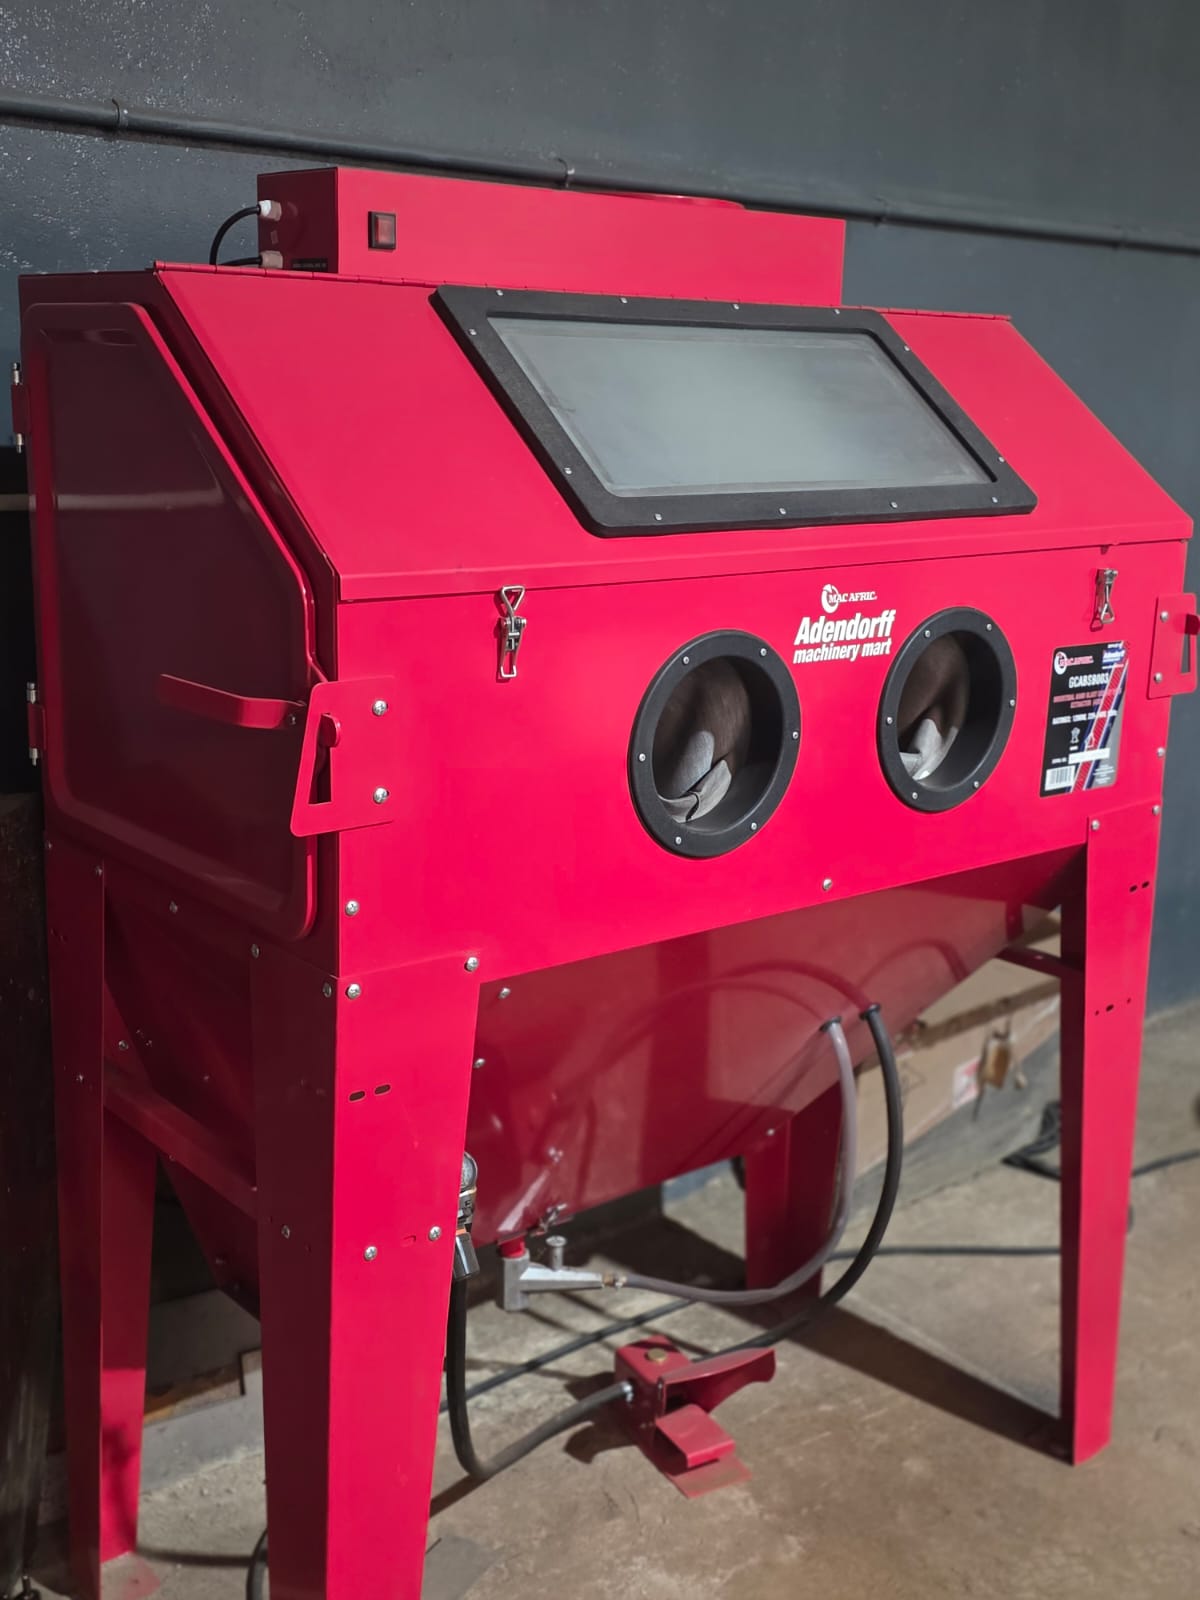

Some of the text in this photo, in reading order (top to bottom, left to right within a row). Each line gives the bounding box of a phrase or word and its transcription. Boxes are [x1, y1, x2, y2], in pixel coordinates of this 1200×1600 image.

[829, 593, 848, 603] MAC
[794, 609, 896, 645] Adendorff
[793, 638, 892, 664] machinery mart
